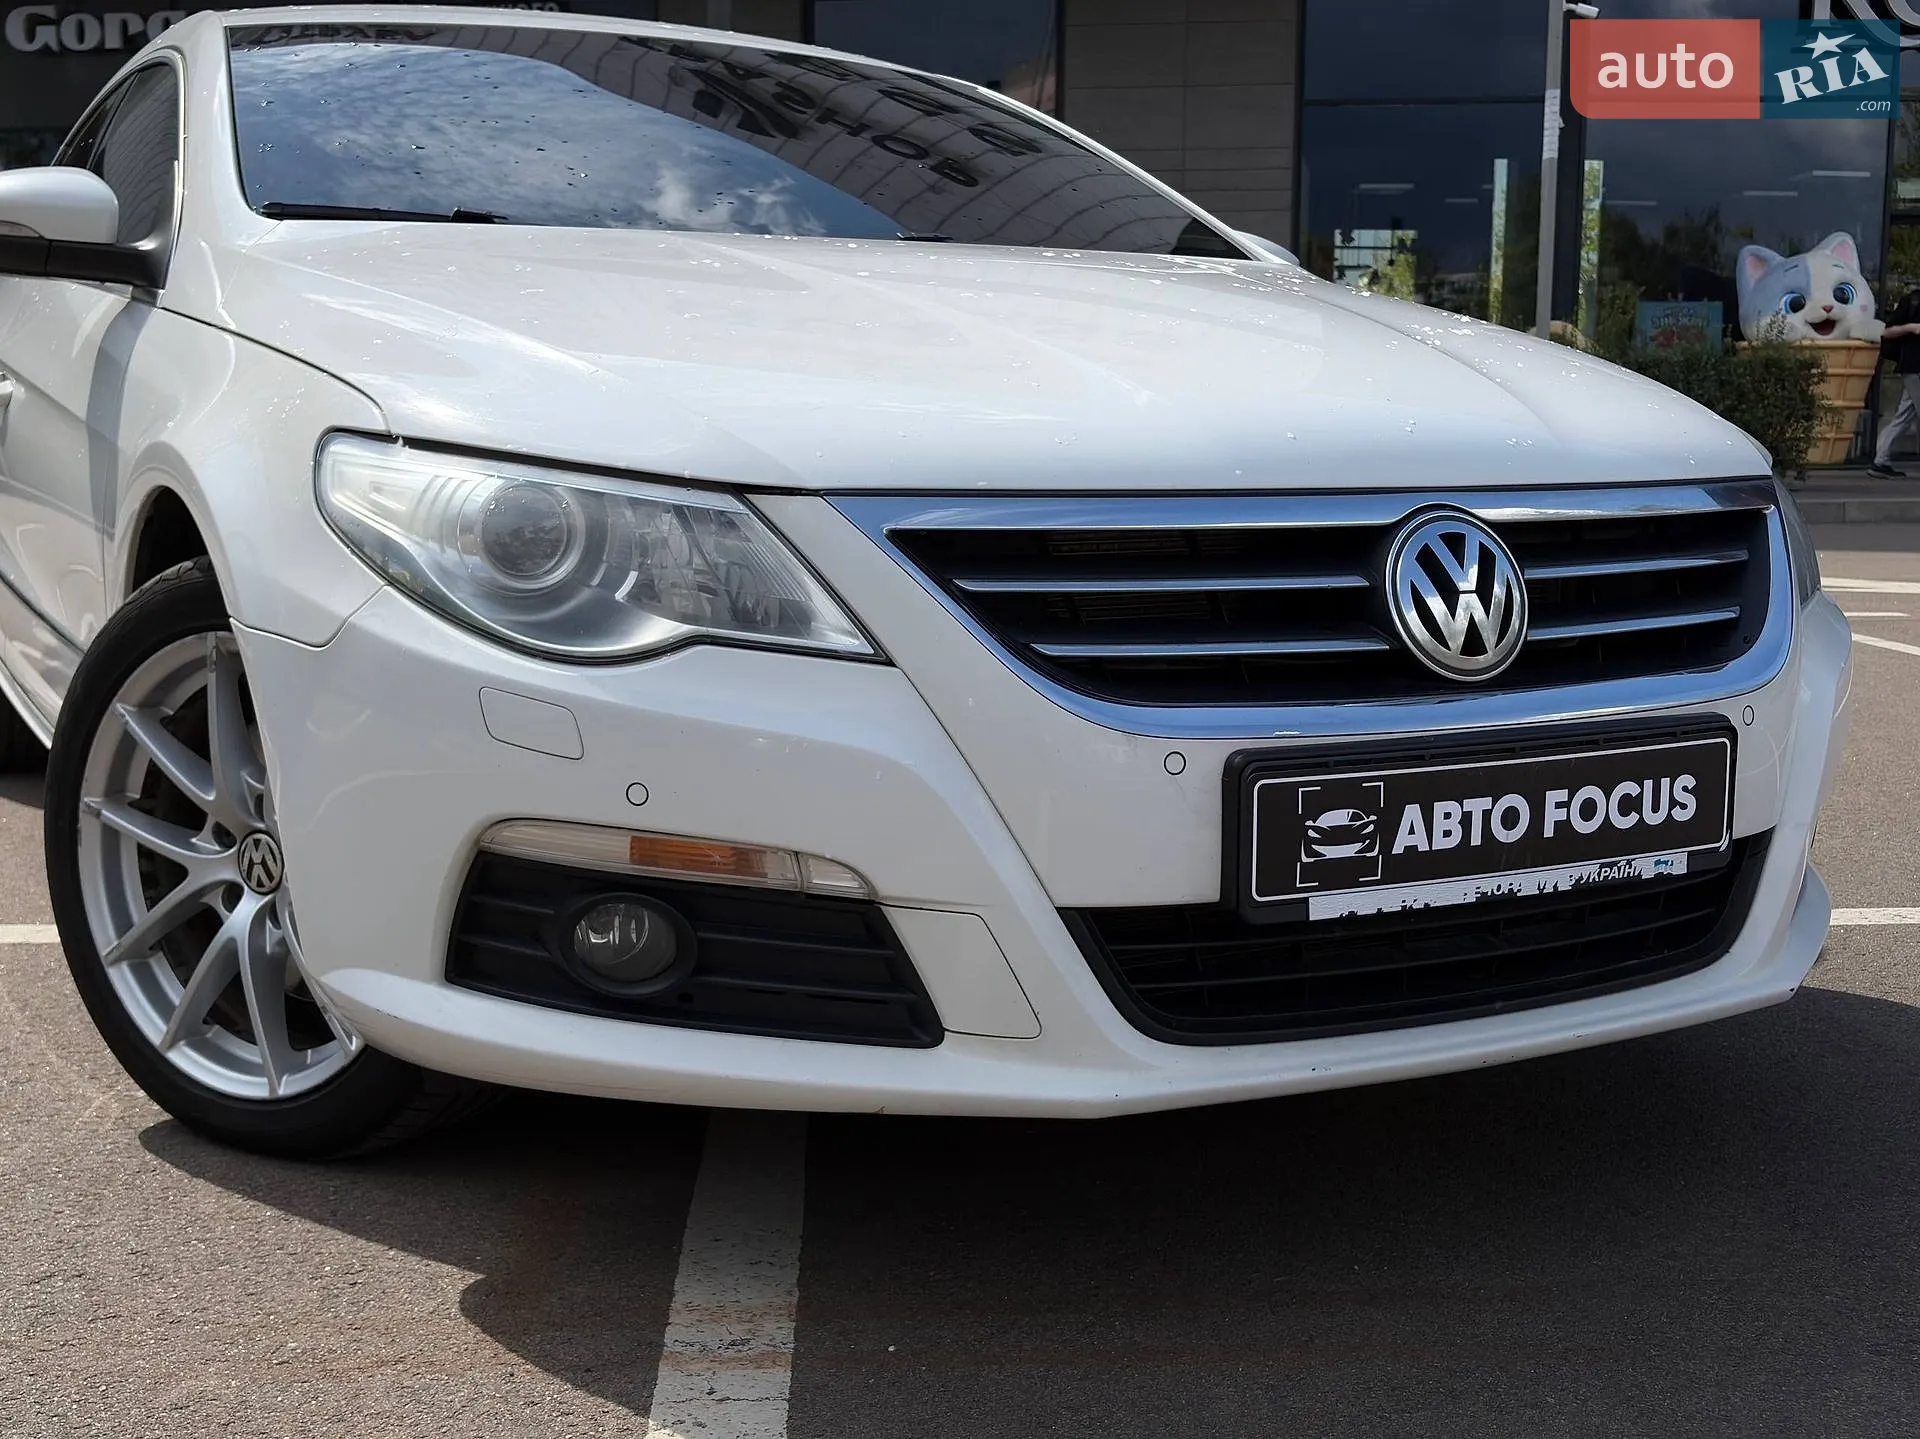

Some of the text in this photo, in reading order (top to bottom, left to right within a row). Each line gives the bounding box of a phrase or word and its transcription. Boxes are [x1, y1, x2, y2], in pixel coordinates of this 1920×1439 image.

[1394, 515, 1522, 671] VW
[1392, 774, 1697, 854] АВТО FOCUS
